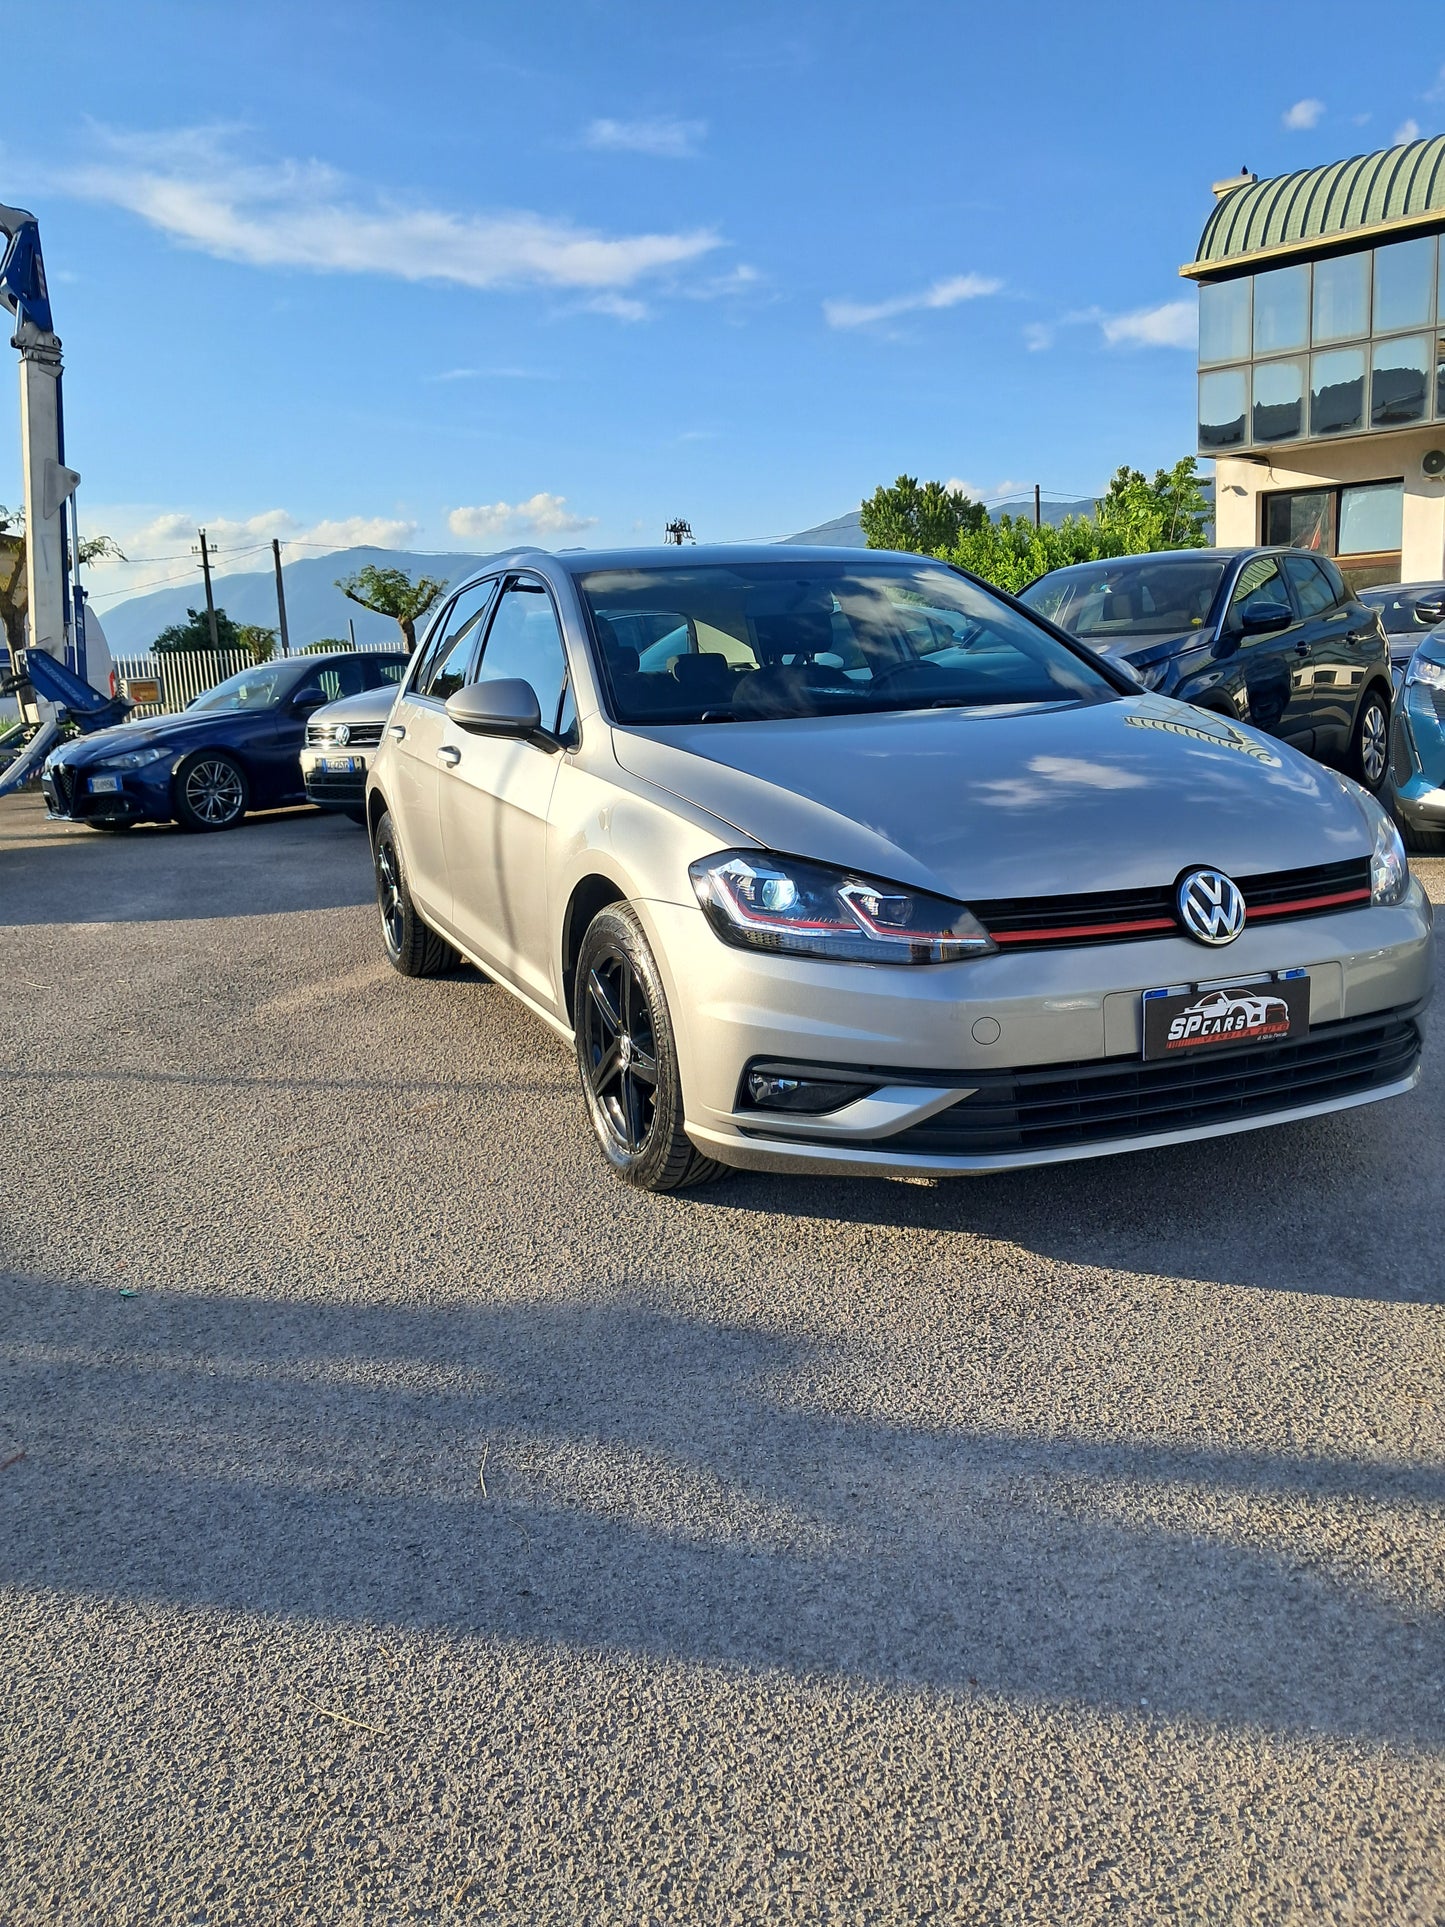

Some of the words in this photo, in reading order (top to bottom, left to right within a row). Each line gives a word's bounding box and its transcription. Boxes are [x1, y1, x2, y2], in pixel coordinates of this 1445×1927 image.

[1184, 873, 1244, 941] VW
[1203, 1029, 1251, 1042] VENDITA
[1257, 1023, 1288, 1034] AUTO
